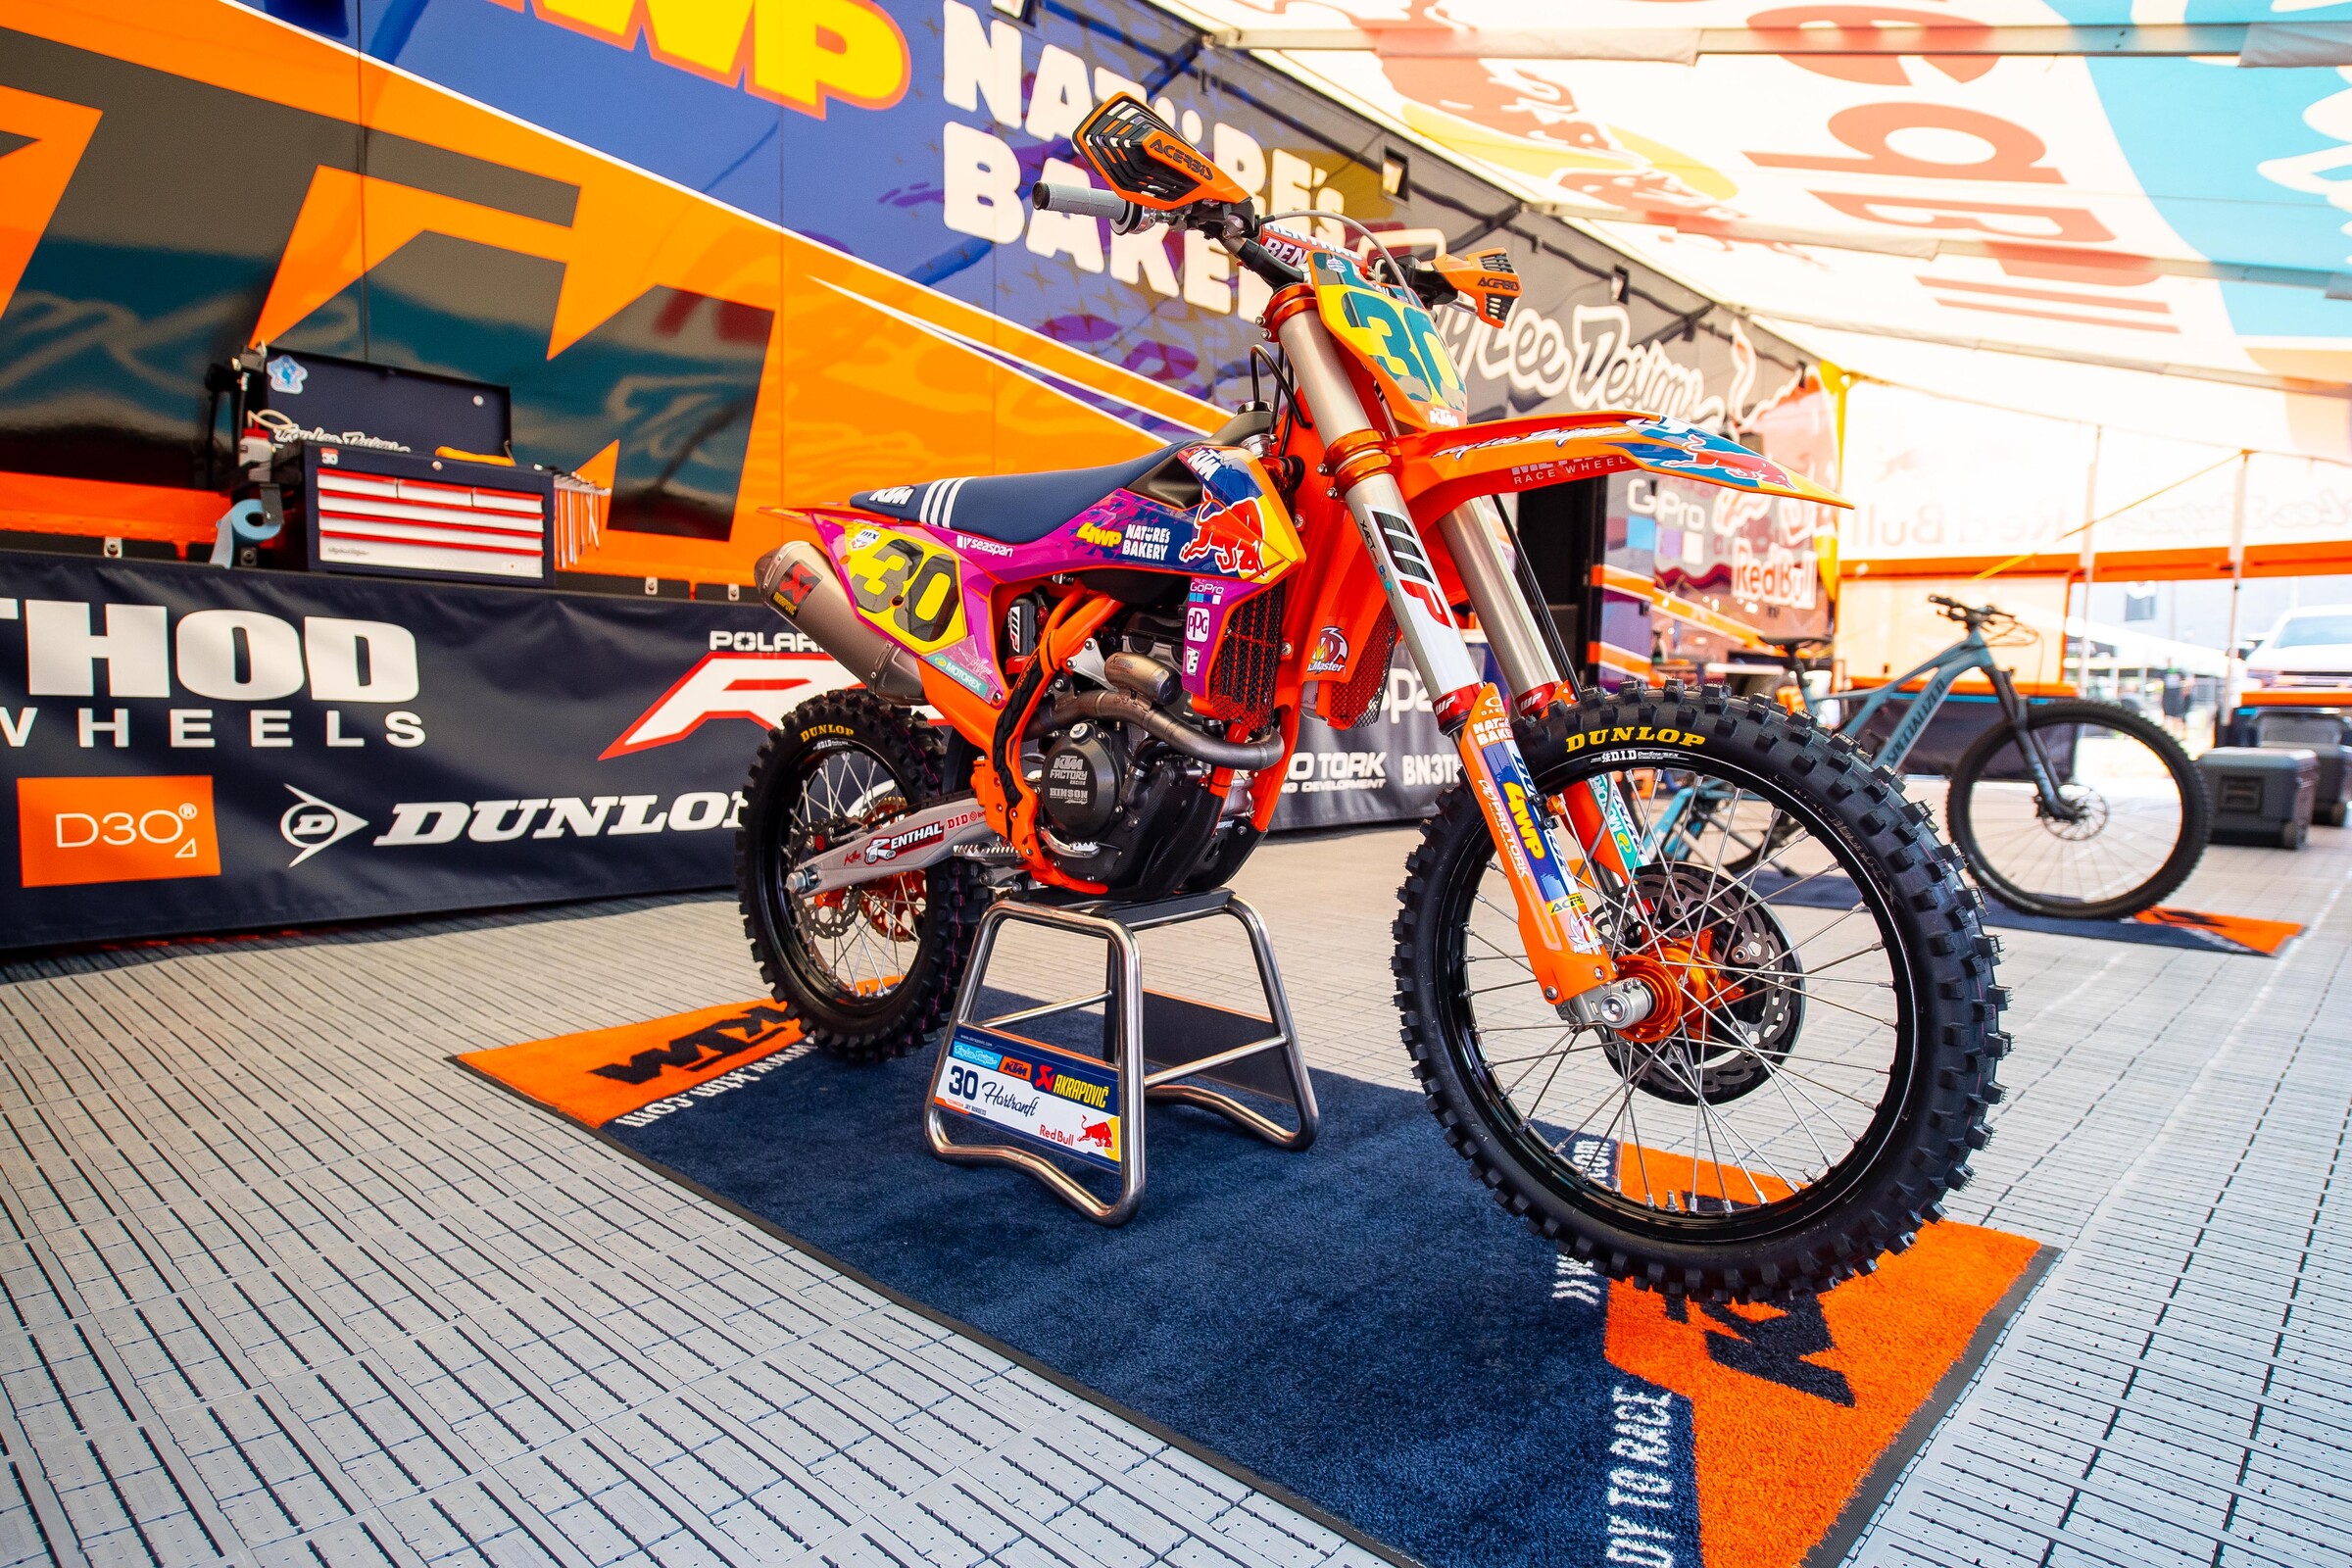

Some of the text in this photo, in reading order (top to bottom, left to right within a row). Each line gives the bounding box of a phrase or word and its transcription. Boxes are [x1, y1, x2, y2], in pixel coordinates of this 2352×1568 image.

[1149, 138, 1214, 181] ACERBIS
[1477, 276, 1520, 292] ACERBIS
[1341, 291, 1467, 412] 30
[1429, 408, 1459, 427] KTM
[1187, 448, 1222, 481] KTM
[1514, 468, 1556, 485] RACE
[868, 486, 915, 506] KTM
[970, 538, 1014, 558] seaspan
[1076, 521, 1122, 548] 4WP
[1122, 539, 1168, 561] BAKERY
[851, 538, 961, 643] 30
[1190, 581, 1225, 595] GoPro
[1187, 610, 1208, 638] PPG
[945, 662, 983, 692] MOTOREX
[1436, 694, 1457, 715] WP
[801, 724, 855, 743] DUNLOP
[1565, 726, 1706, 753] DUNLOP
[1050, 769, 1089, 781] FACTORY
[1054, 755, 1084, 770] KTM
[1317, 751, 1389, 780] TORK
[1050, 787, 1089, 799] HINSON
[1502, 781, 1545, 859] 4WP
[865, 822, 943, 864] RENTHAL
[1491, 800, 1531, 878] PRO TORK
[1004, 1060, 1028, 1077] KTM
[949, 1065, 1041, 1117] 30 Hartranft
[1053, 1074, 1109, 1108] AKRAPOVIČ
[1040, 1123, 1074, 1147] Red Bull
[1609, 1386, 1673, 1466] RACE
[1607, 1465, 1673, 1509] TO
